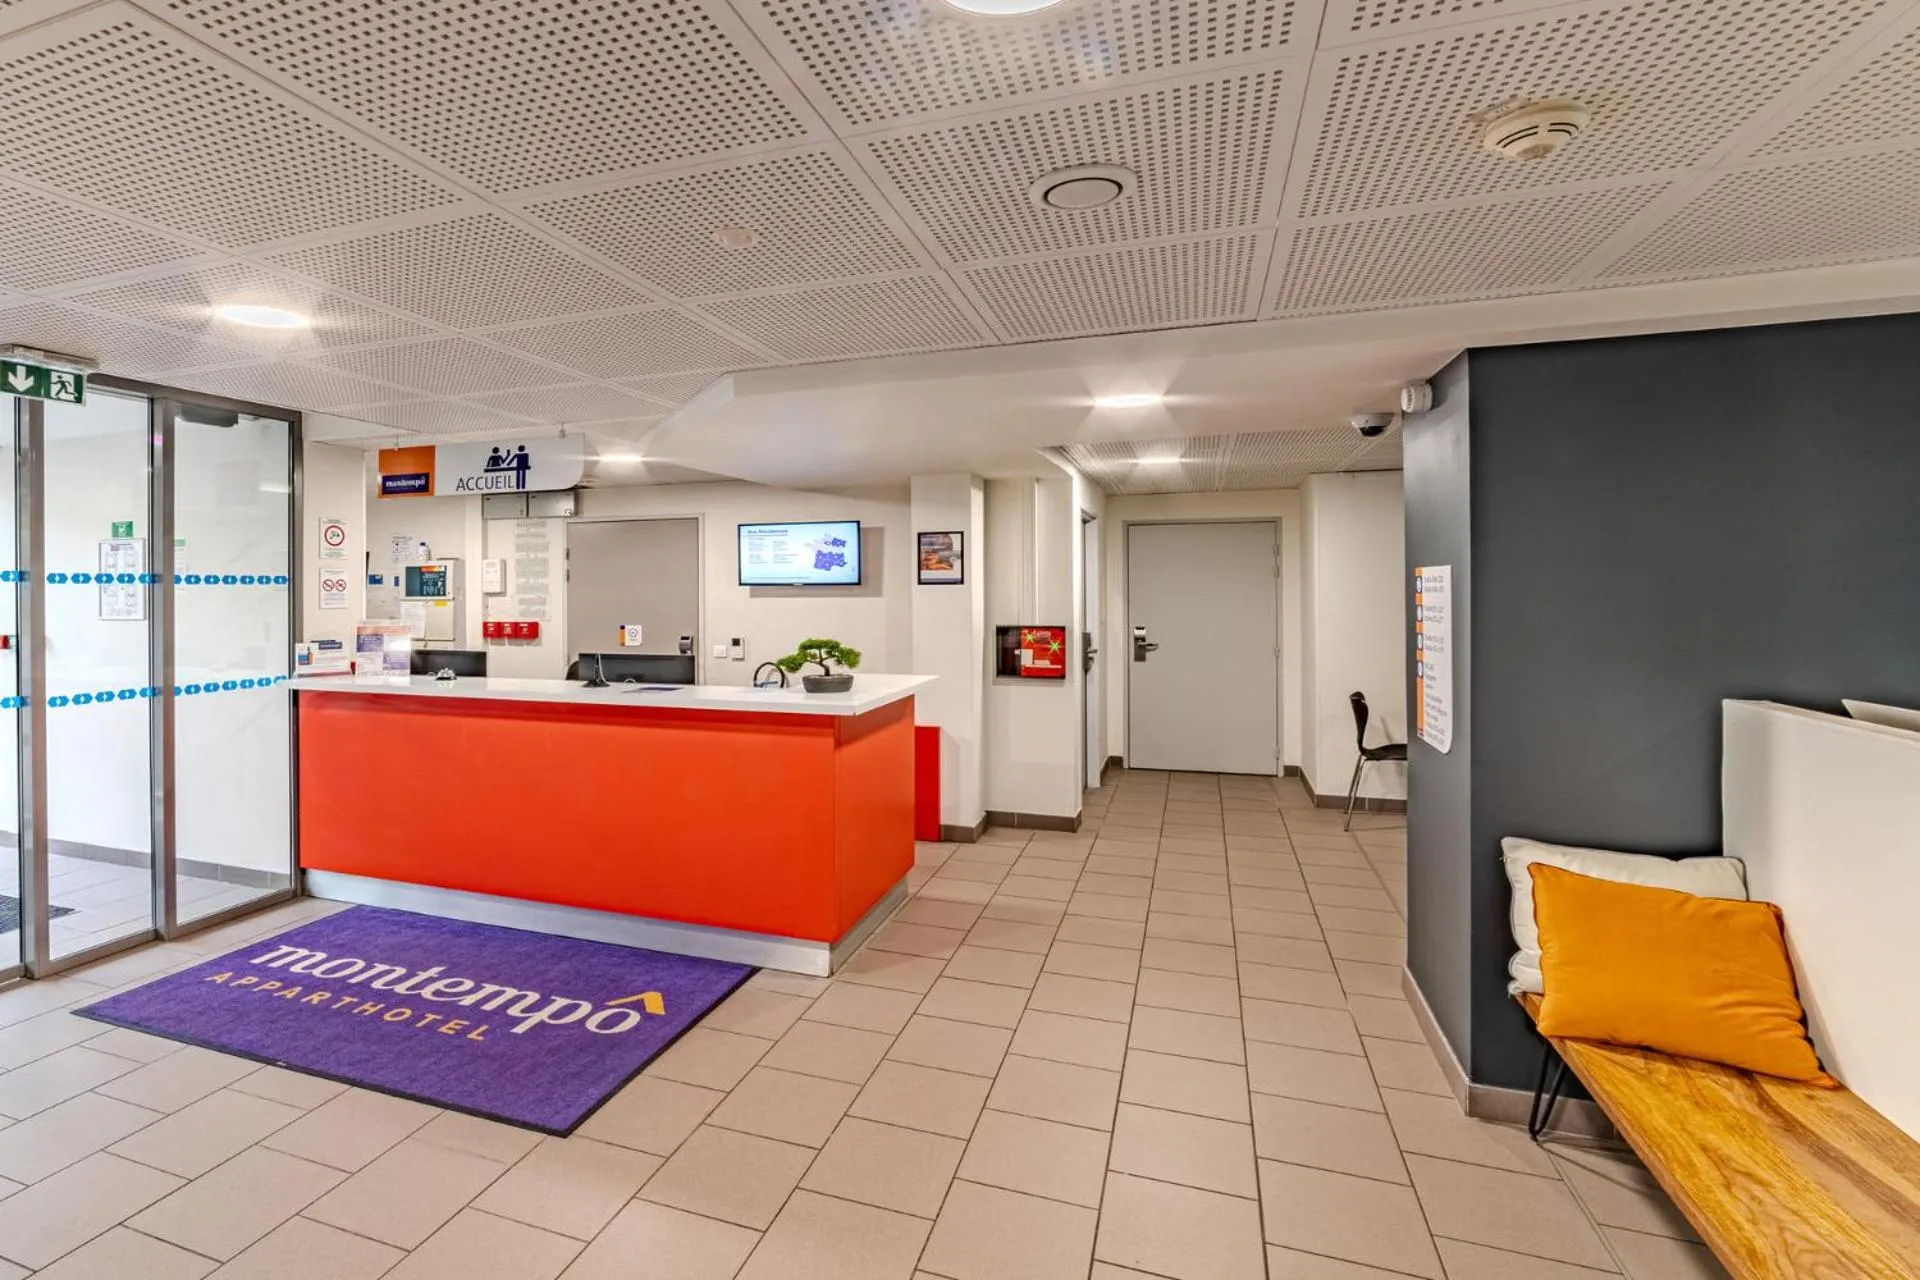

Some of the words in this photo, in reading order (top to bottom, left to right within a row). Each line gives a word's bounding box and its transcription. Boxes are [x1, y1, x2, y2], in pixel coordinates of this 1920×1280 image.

[456, 475, 515, 492] ACCUEIL
[205, 972, 489, 1041] APPARTHOTEL
[250, 945, 665, 1034] montempô
